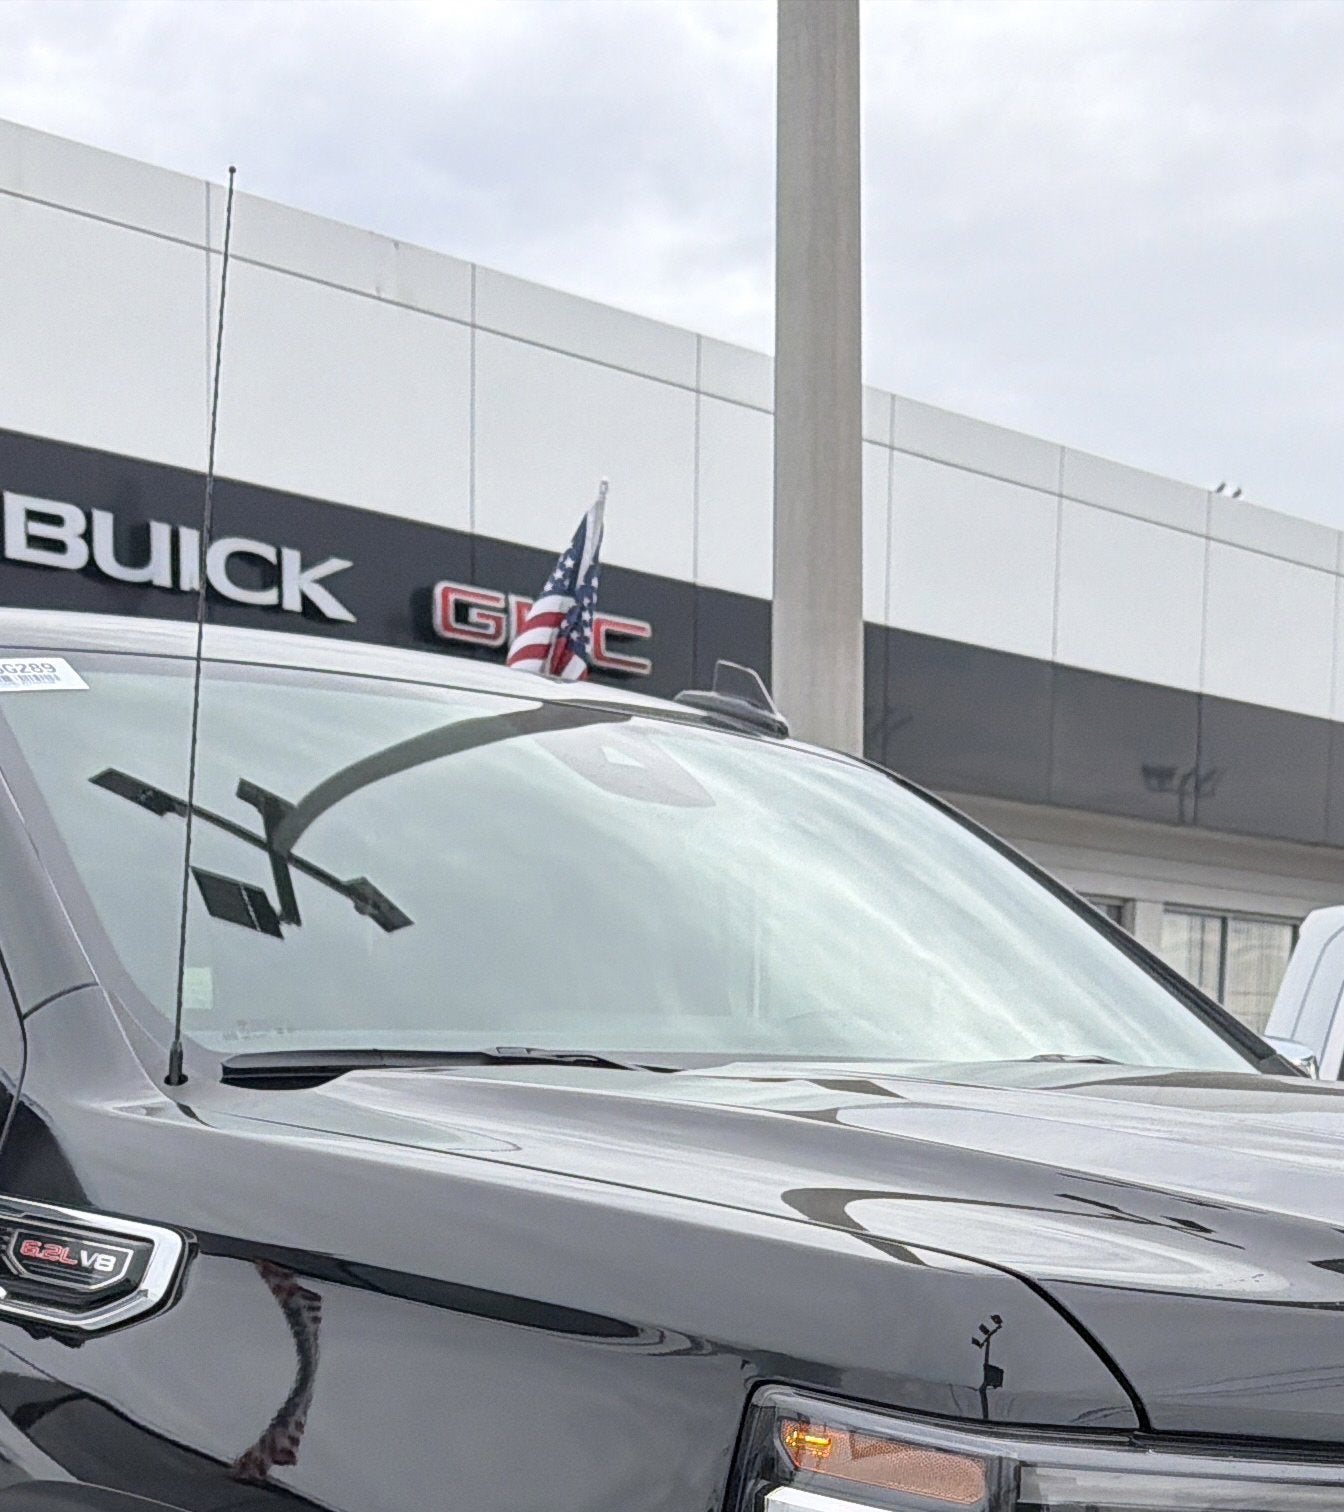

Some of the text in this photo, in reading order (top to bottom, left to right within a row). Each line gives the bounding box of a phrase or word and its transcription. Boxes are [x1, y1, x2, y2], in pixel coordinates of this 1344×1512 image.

[2, 490, 356, 623] BUICK
[433, 580, 652, 675] GC
[20, 1239, 116, 1272] 6.2L V8
